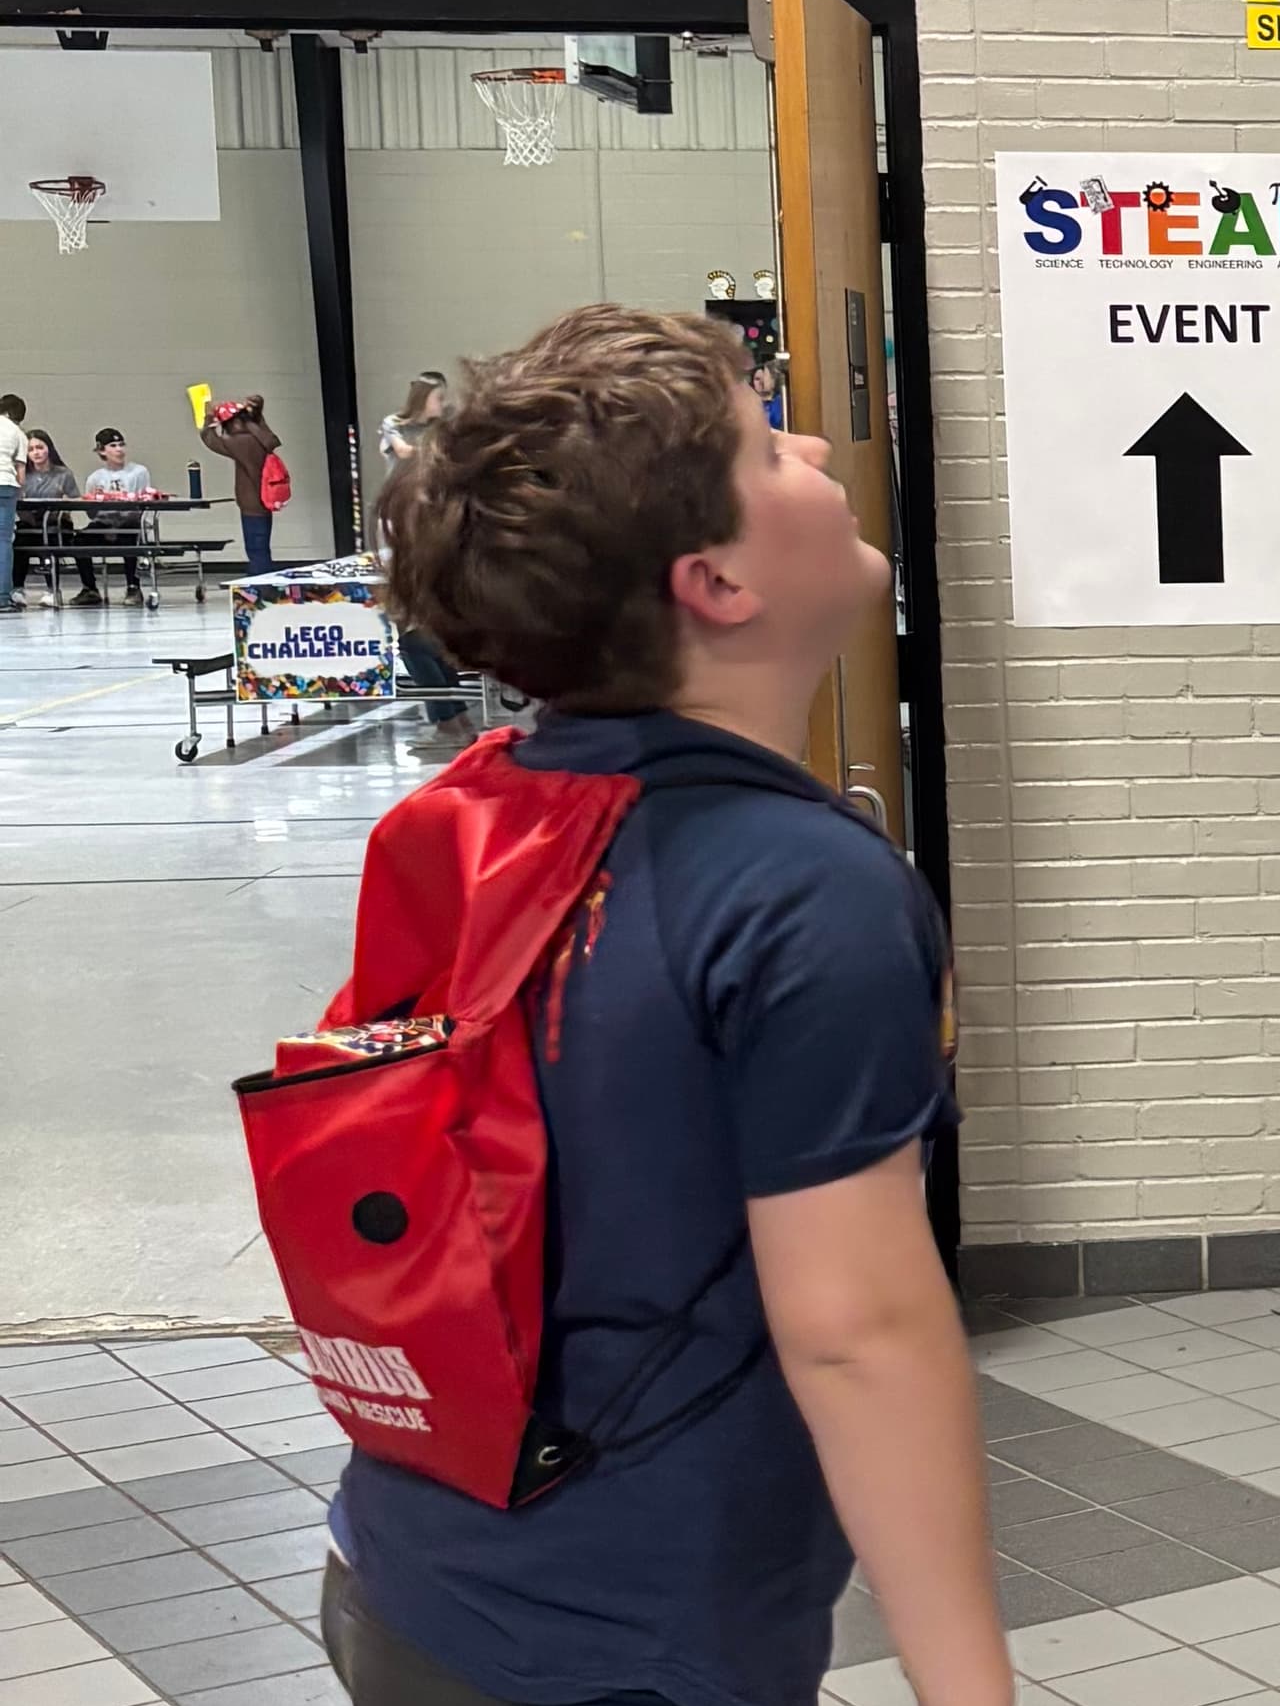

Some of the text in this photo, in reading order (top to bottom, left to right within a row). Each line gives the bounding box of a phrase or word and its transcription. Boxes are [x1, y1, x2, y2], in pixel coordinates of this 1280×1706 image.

[1035, 259, 1084, 269] SCIENCE
[1099, 259, 1174, 270] TECHNOLOGY
[1188, 260, 1263, 270] ENGINEERING
[1110, 304, 1270, 344] EVENT
[284, 625, 344, 643] LEGO
[248, 640, 381, 659] CHALLENGE
